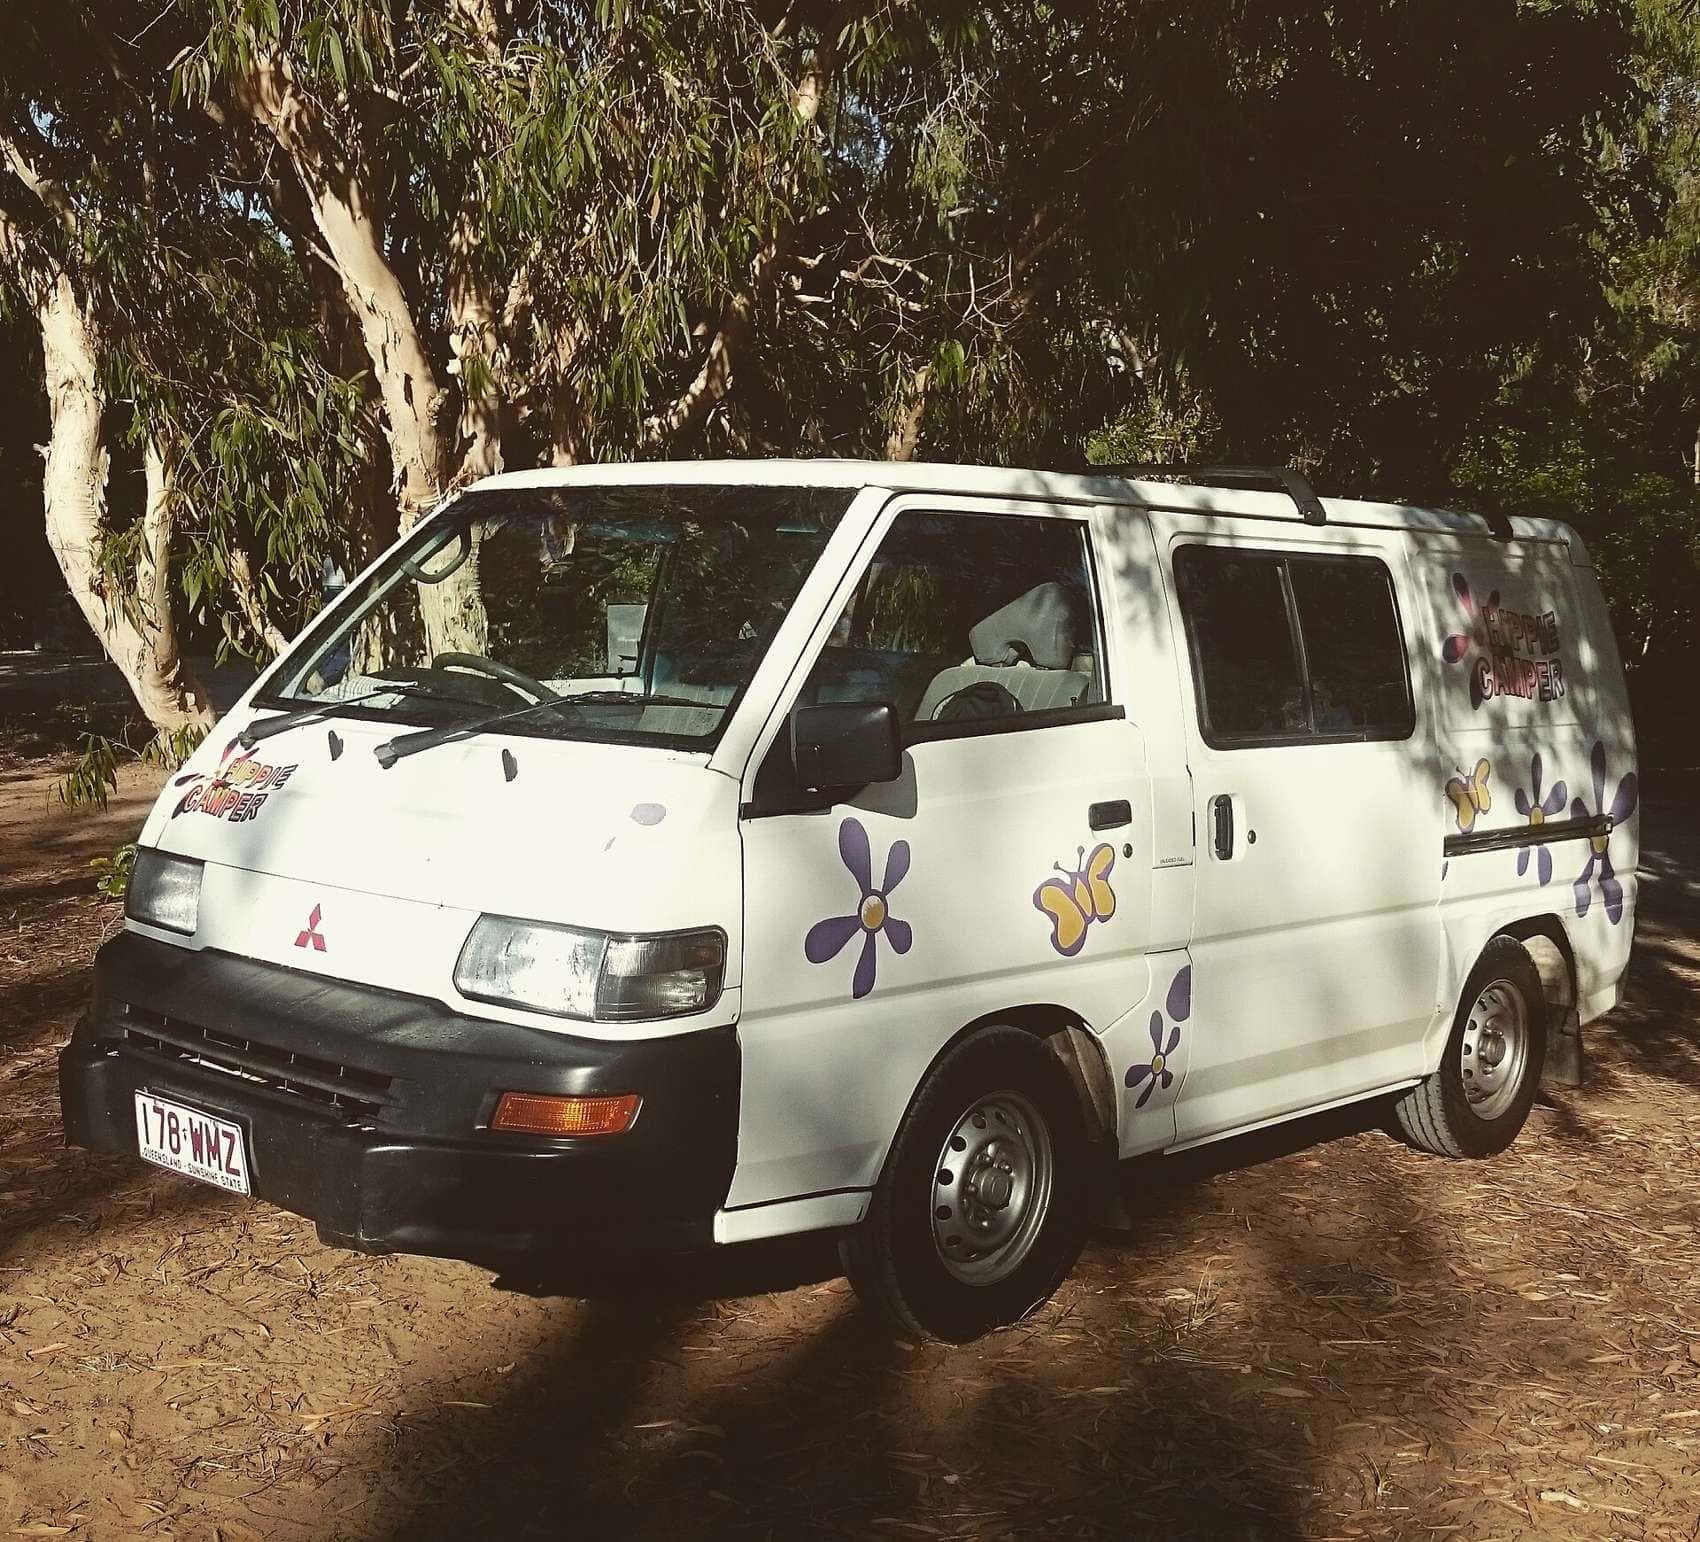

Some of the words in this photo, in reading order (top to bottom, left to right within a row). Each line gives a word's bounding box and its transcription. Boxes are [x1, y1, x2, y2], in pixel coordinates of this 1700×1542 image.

[1482, 606, 1560, 655] HIPPIE
[1476, 655, 1565, 702] CAMPER
[221, 757, 299, 791] HIPPIE
[183, 784, 269, 822] CAMPER
[143, 1146, 183, 1170] QUEENSLAND
[187, 1162, 218, 1183] SUNSHINE
[220, 1173, 242, 1191] STATE
